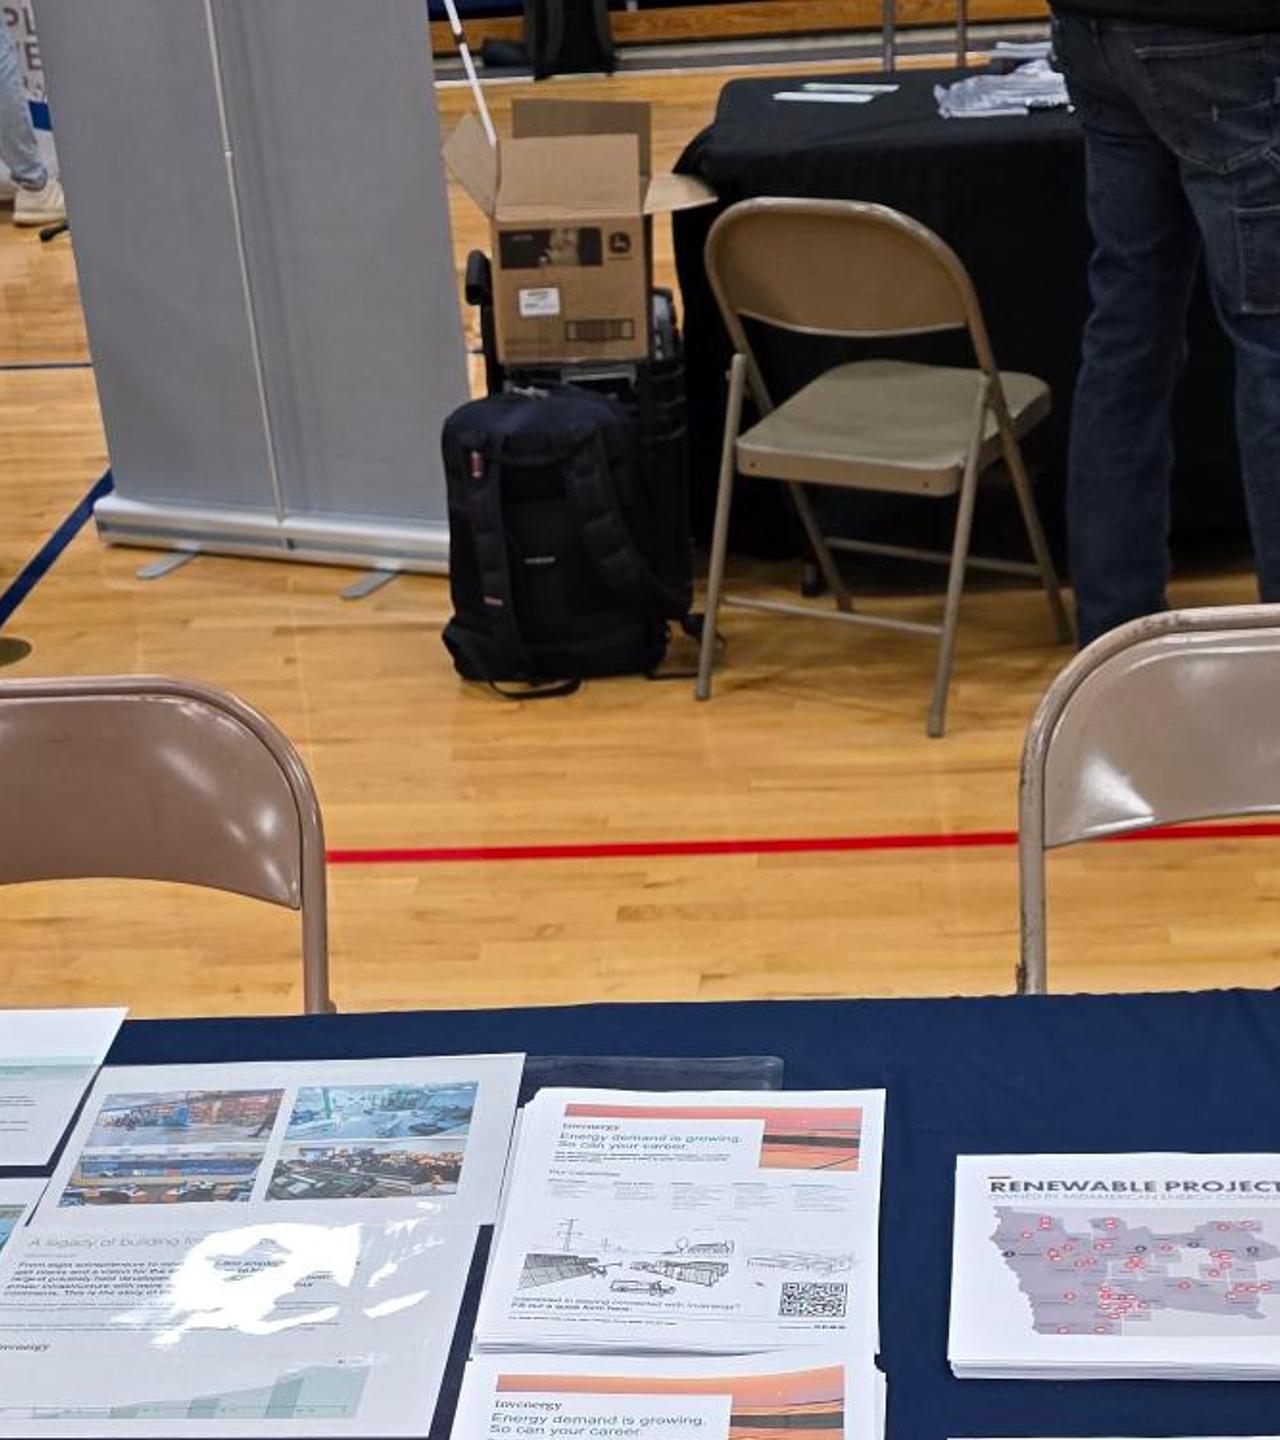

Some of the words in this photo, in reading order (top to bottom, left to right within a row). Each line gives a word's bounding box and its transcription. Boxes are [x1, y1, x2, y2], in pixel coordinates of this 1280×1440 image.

[560, 1132, 608, 1142] Energy
[611, 1134, 667, 1142] demand
[608, 1143, 639, 1151] your
[990, 1180, 1157, 1193] RENEWABLE
[494, 1399, 563, 1411] Invenergy
[491, 1412, 547, 1424] Energy
[552, 1413, 618, 1425] demand
[622, 1414, 635, 1425] is
[489, 1423, 513, 1434] So
[516, 1425, 544, 1435] can
[549, 1426, 586, 1437] your
